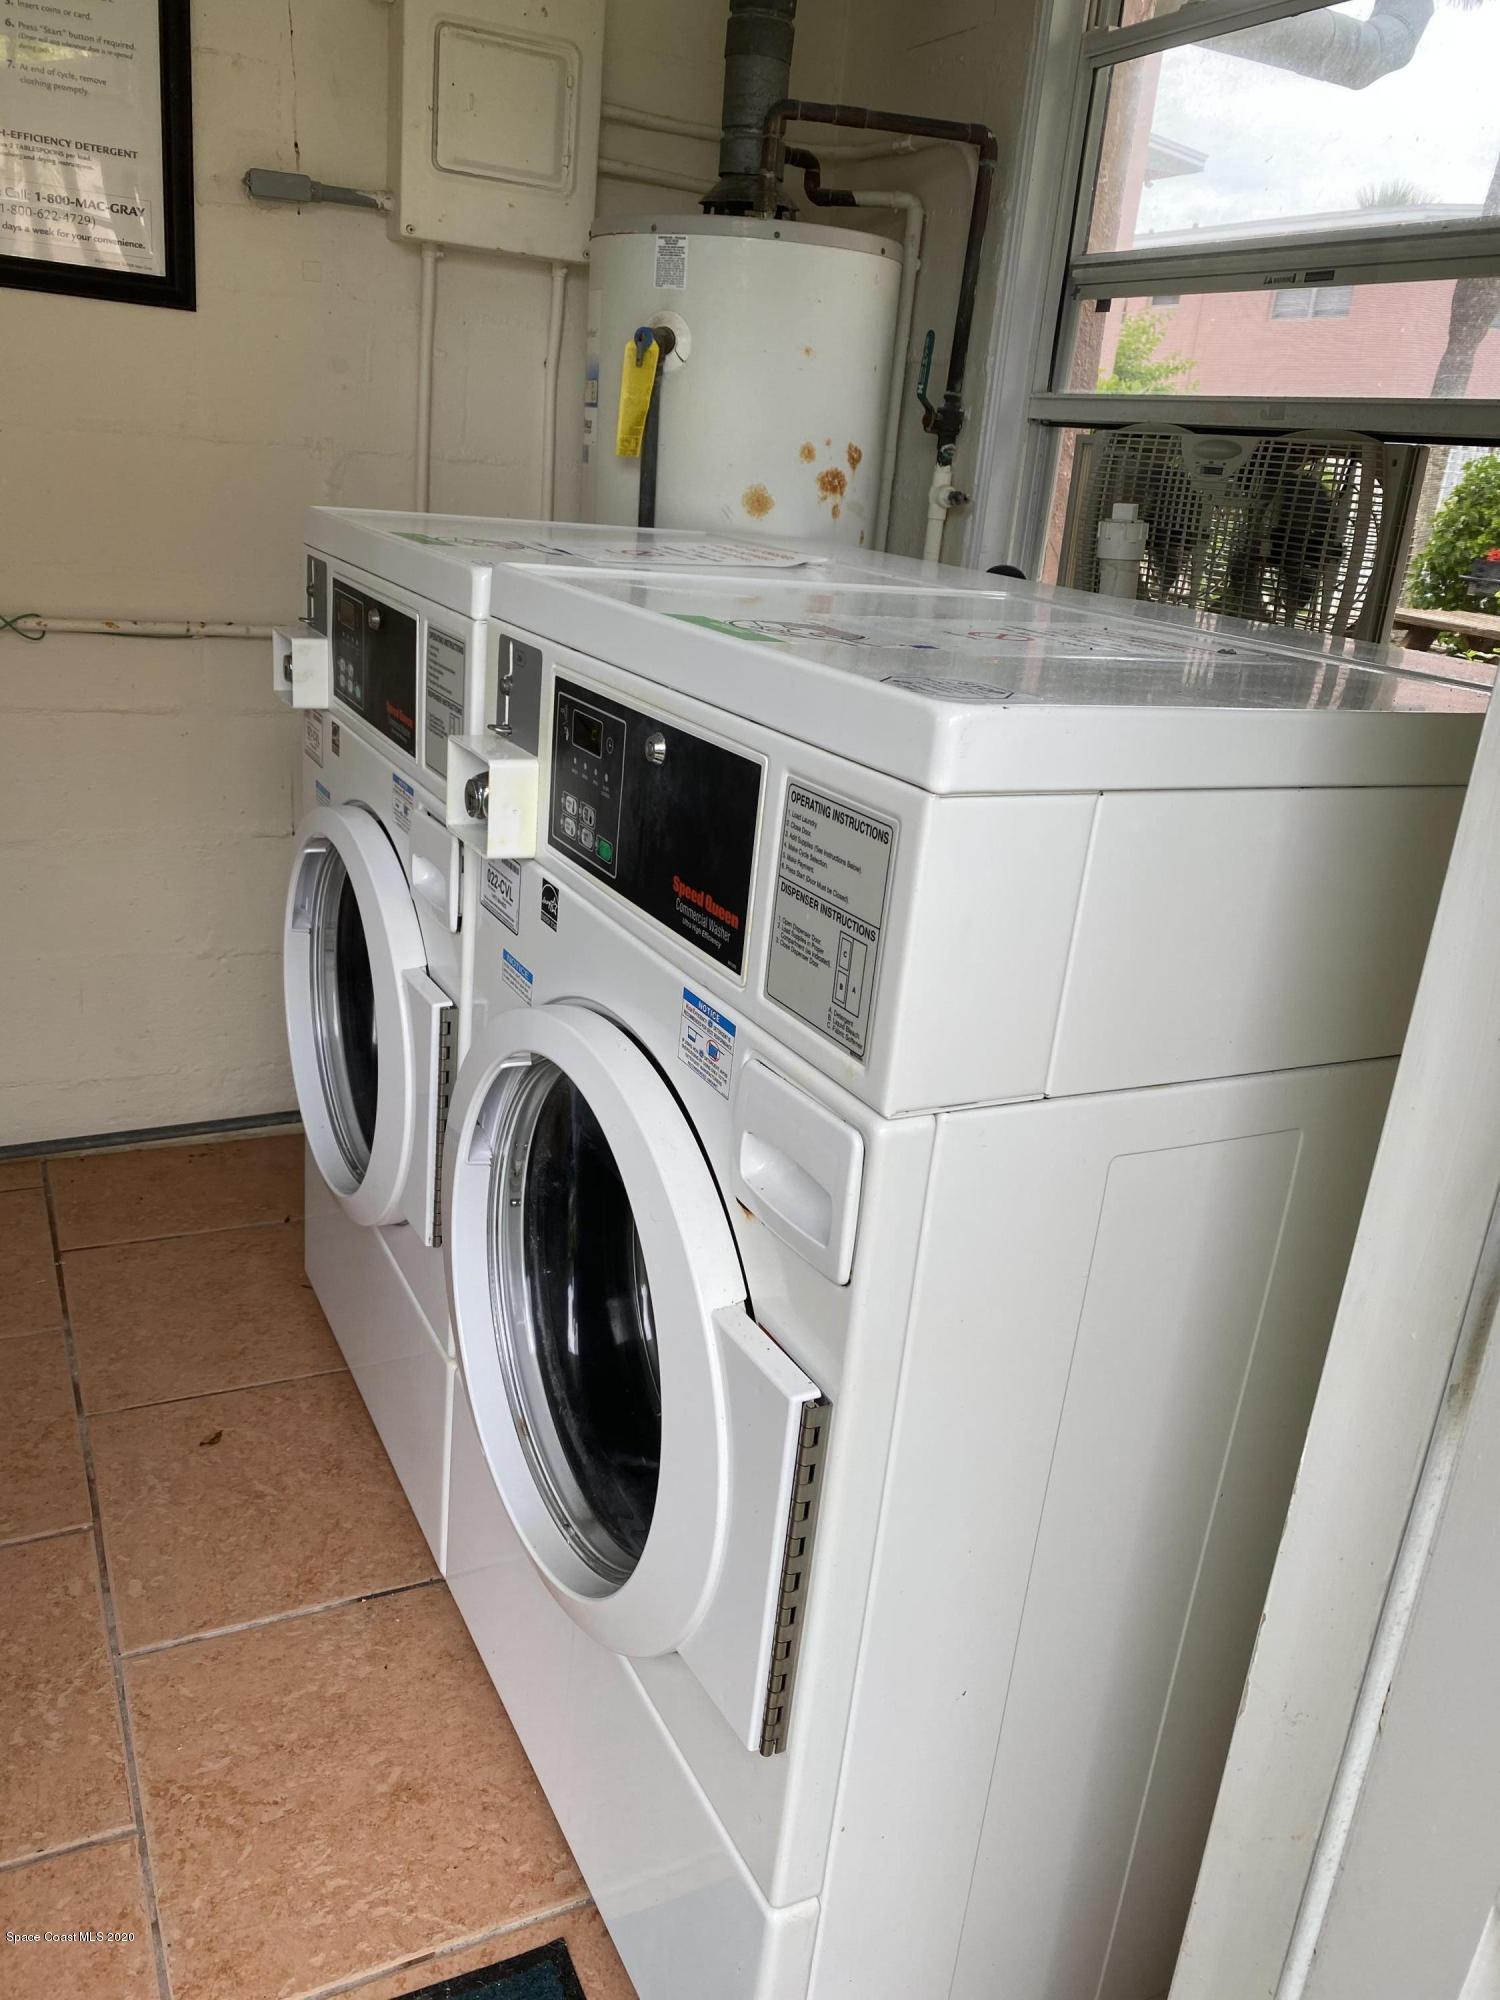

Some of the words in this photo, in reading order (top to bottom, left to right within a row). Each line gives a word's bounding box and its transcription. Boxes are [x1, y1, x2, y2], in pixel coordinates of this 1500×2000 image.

[18, 0, 39, 10] Insert
[5, 18, 14, 28] 6.
[18, 21, 37, 31] Press
[68, 31, 94, 42] button
[104, 39, 136, 51] required.
[7, 59, 16, 69] 7.
[20, 63, 28, 71] At
[30, 65, 45, 75] end
[47, 67, 55, 76] of
[57, 70, 78, 82] cycle,
[79, 75, 107, 86] remove
[19, 76, 52, 91] clothing
[75, 141, 138, 159] DETERGENT
[35, 192, 145, 216] 1-800-MAC-GRAY
[2, 221, 22, 233] days
[32, 226, 54, 236] week
[57, 228, 69, 238] for
[71, 231, 91, 242] your
[93, 236, 145, 249] convenience.
[791, 791, 831, 818] OPERATING
[832, 809, 889, 844] INSTRUCTIONS
[673, 875, 704, 908] Speed
[705, 895, 739, 929] Queen
[781, 882, 818, 910] DISPENSER
[820, 904, 876, 941] INSTRUCTIONS
[676, 898, 707, 928] Commercial
[708, 918, 731, 942] Washer
[852, 986, 856, 994] A
[699, 1000, 721, 1023] NOTICE
